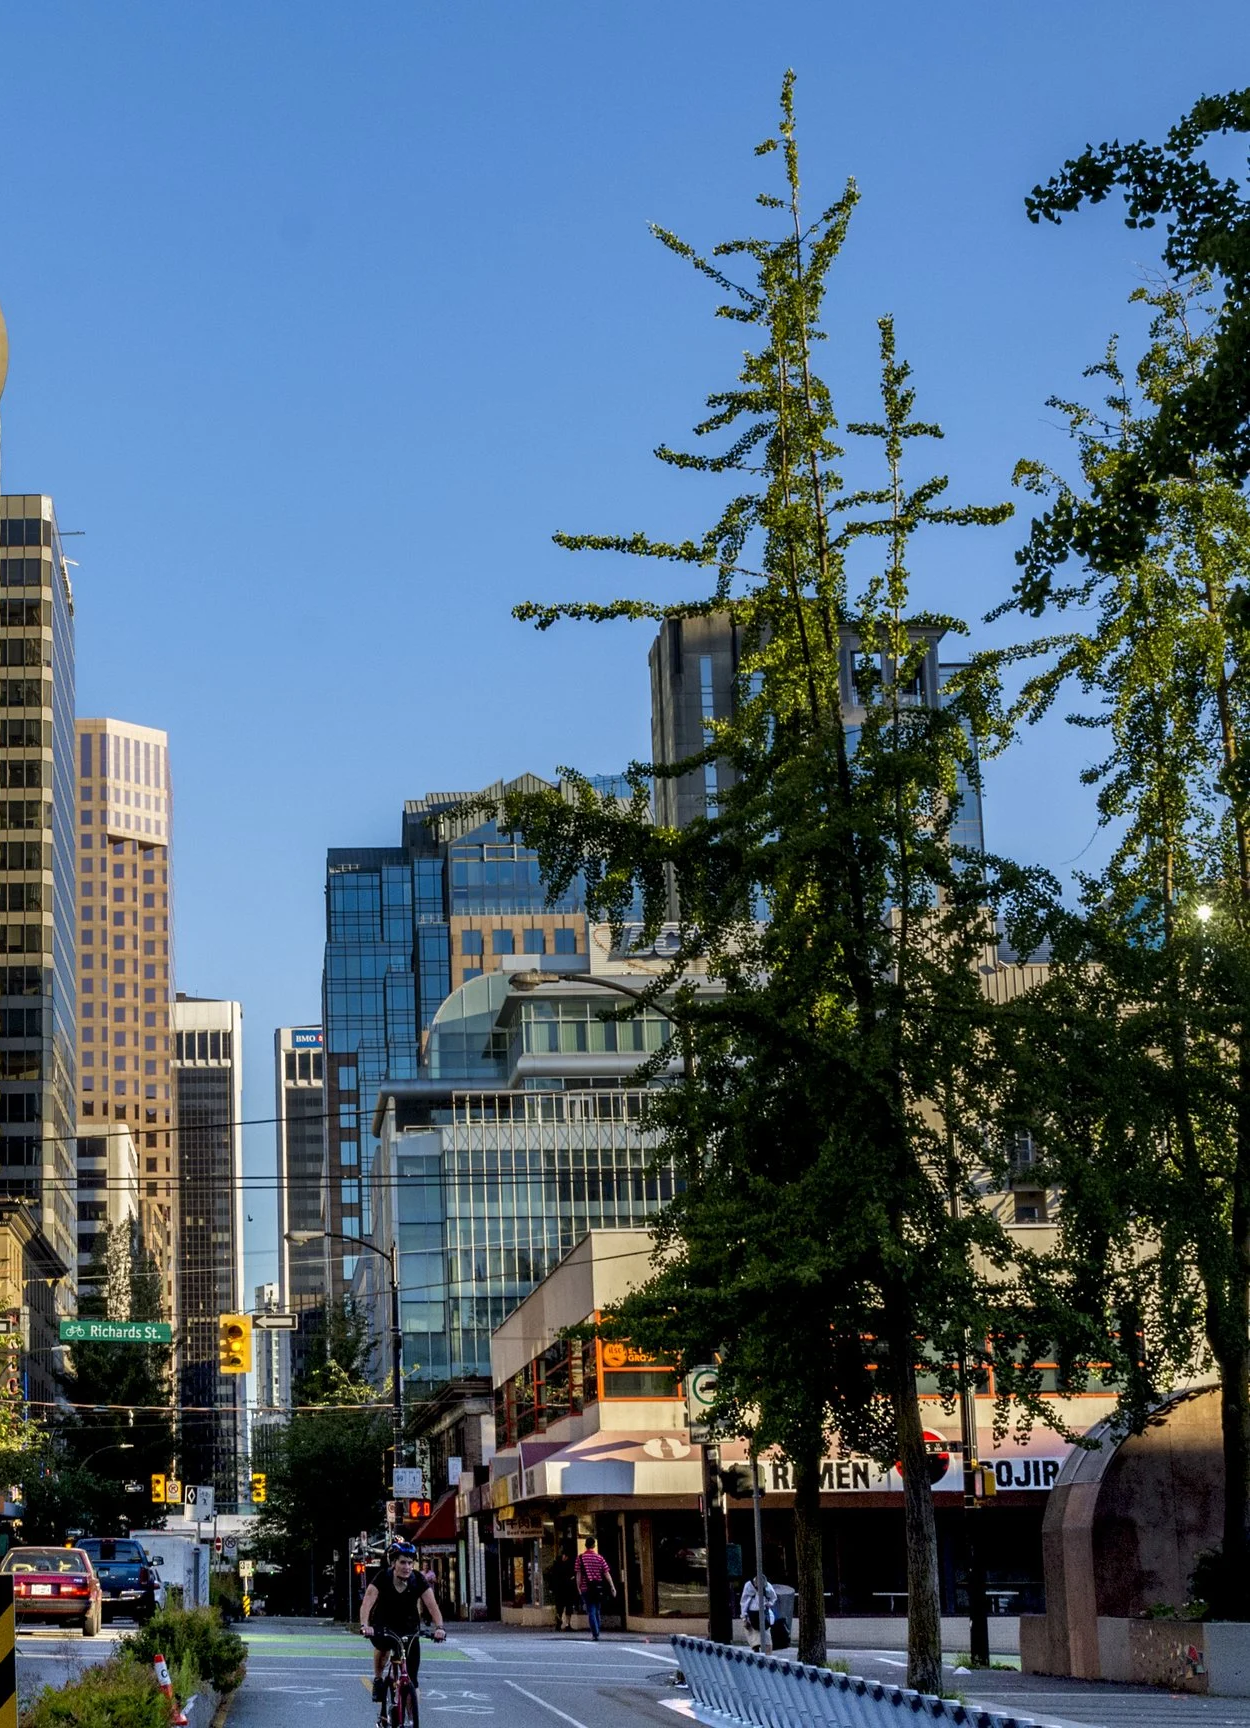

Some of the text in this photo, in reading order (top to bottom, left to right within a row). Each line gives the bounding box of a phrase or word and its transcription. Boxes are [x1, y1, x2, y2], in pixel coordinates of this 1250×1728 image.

[295, 1034, 316, 1043] BMO
[90, 1325, 161, 1339] Richards St.
[772, 1461, 870, 1490] RMEN
